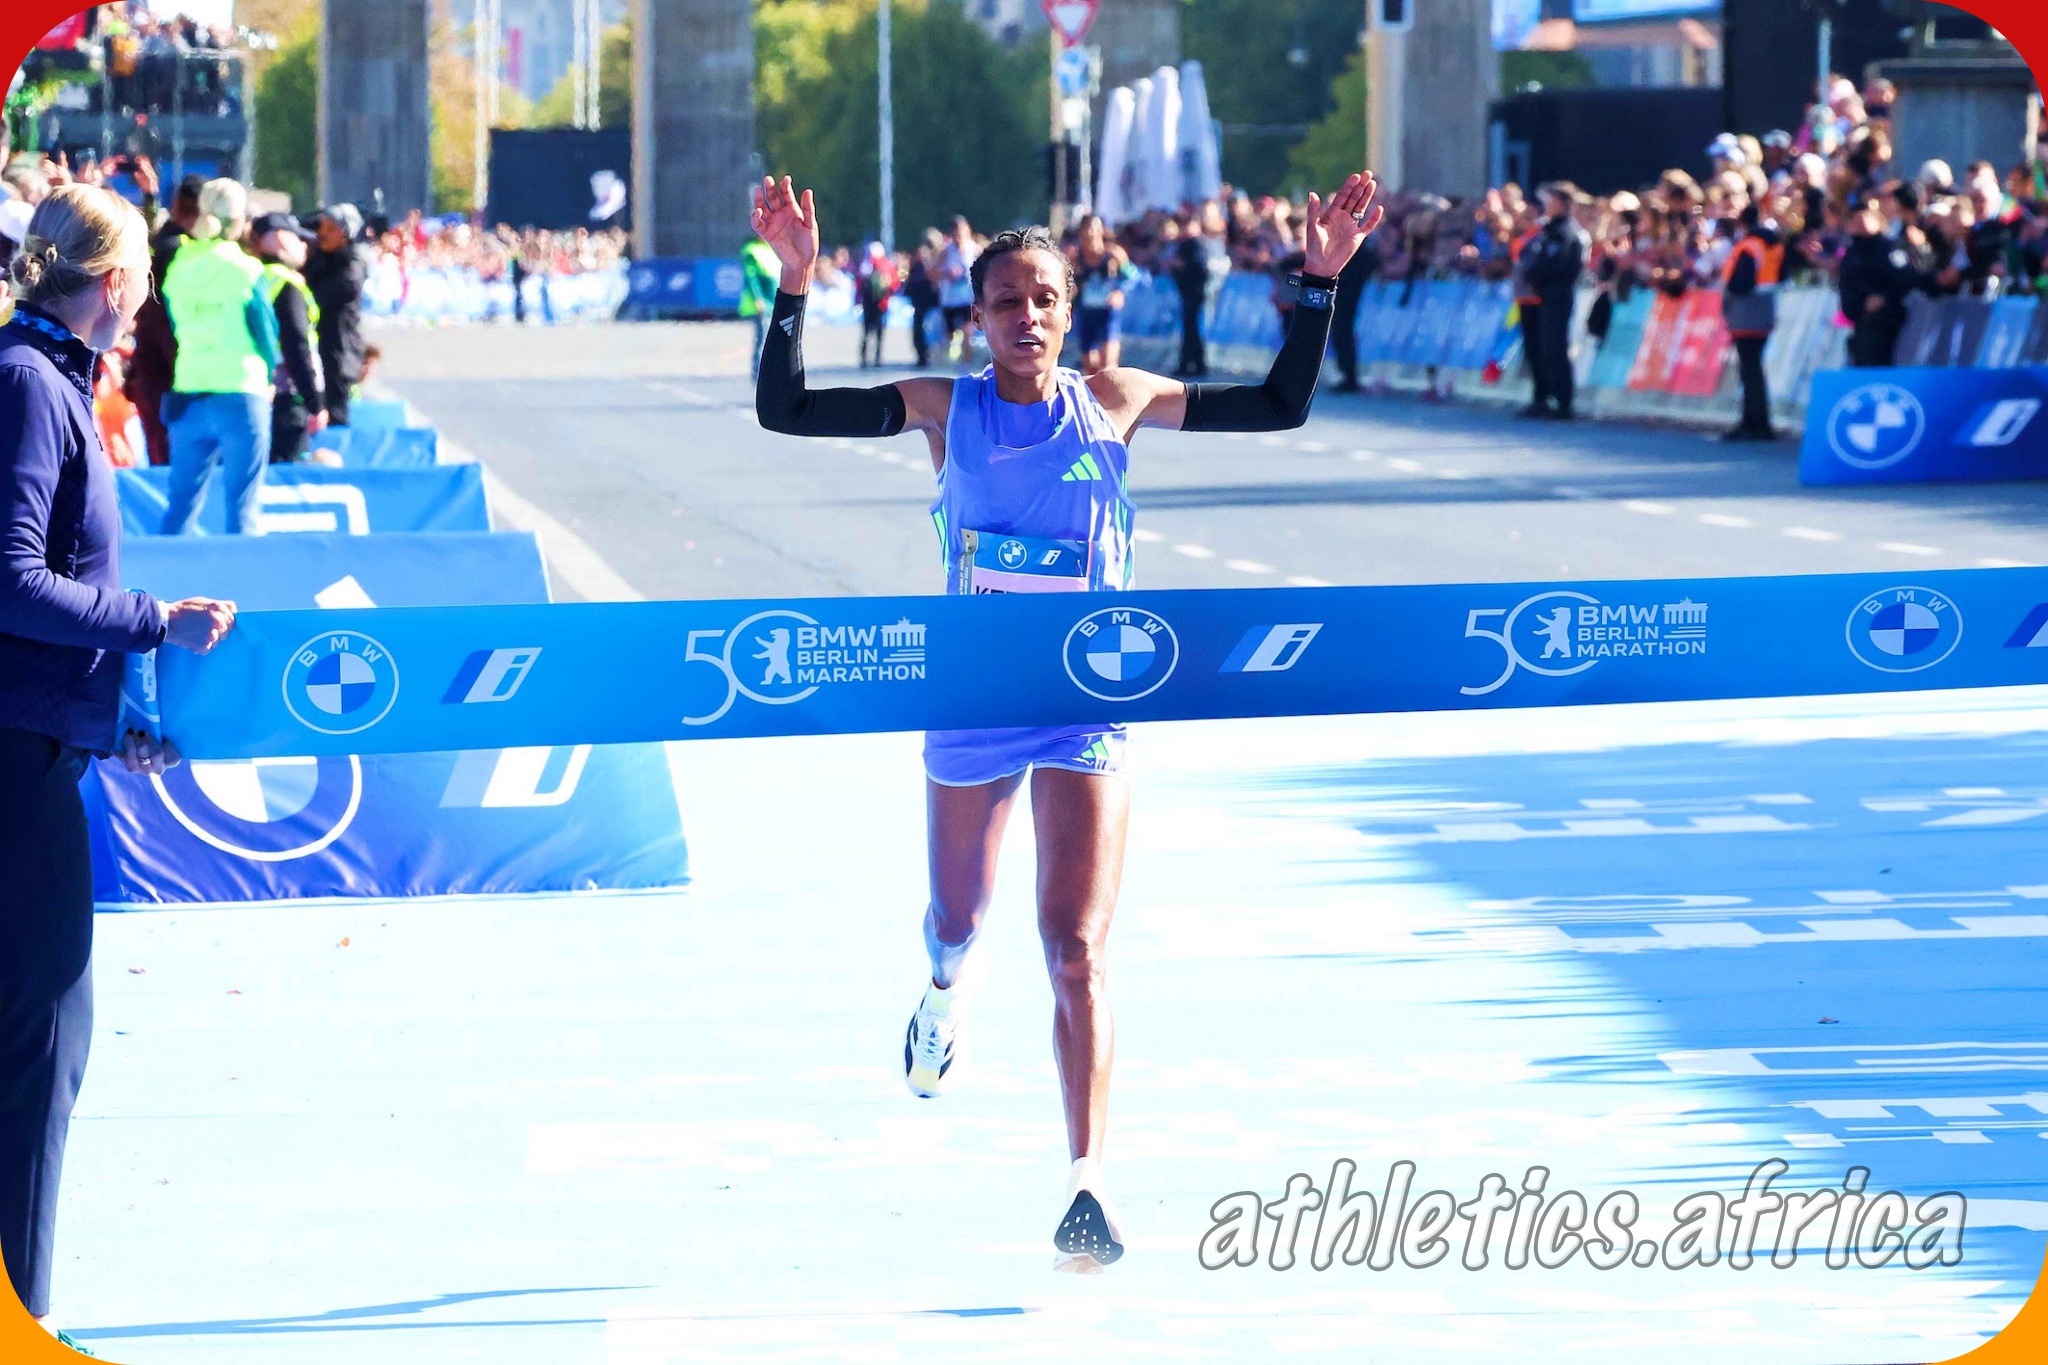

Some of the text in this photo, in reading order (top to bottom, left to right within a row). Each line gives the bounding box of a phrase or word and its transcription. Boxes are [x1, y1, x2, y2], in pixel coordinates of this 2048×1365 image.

[1577, 604, 1659, 626] BMW
[1863, 590, 1948, 616] BMW
[797, 625, 877, 649] BMW
[1078, 612, 1164, 638] BMW
[1577, 626, 1660, 642] BERLIN
[298, 636, 383, 668] BMW
[1459, 591, 1602, 696] 50
[1577, 641, 1707, 658] MARATHON
[681, 610, 820, 726] 50
[797, 649, 879, 666] BERLIN
[797, 664, 926, 684] MARATHON
